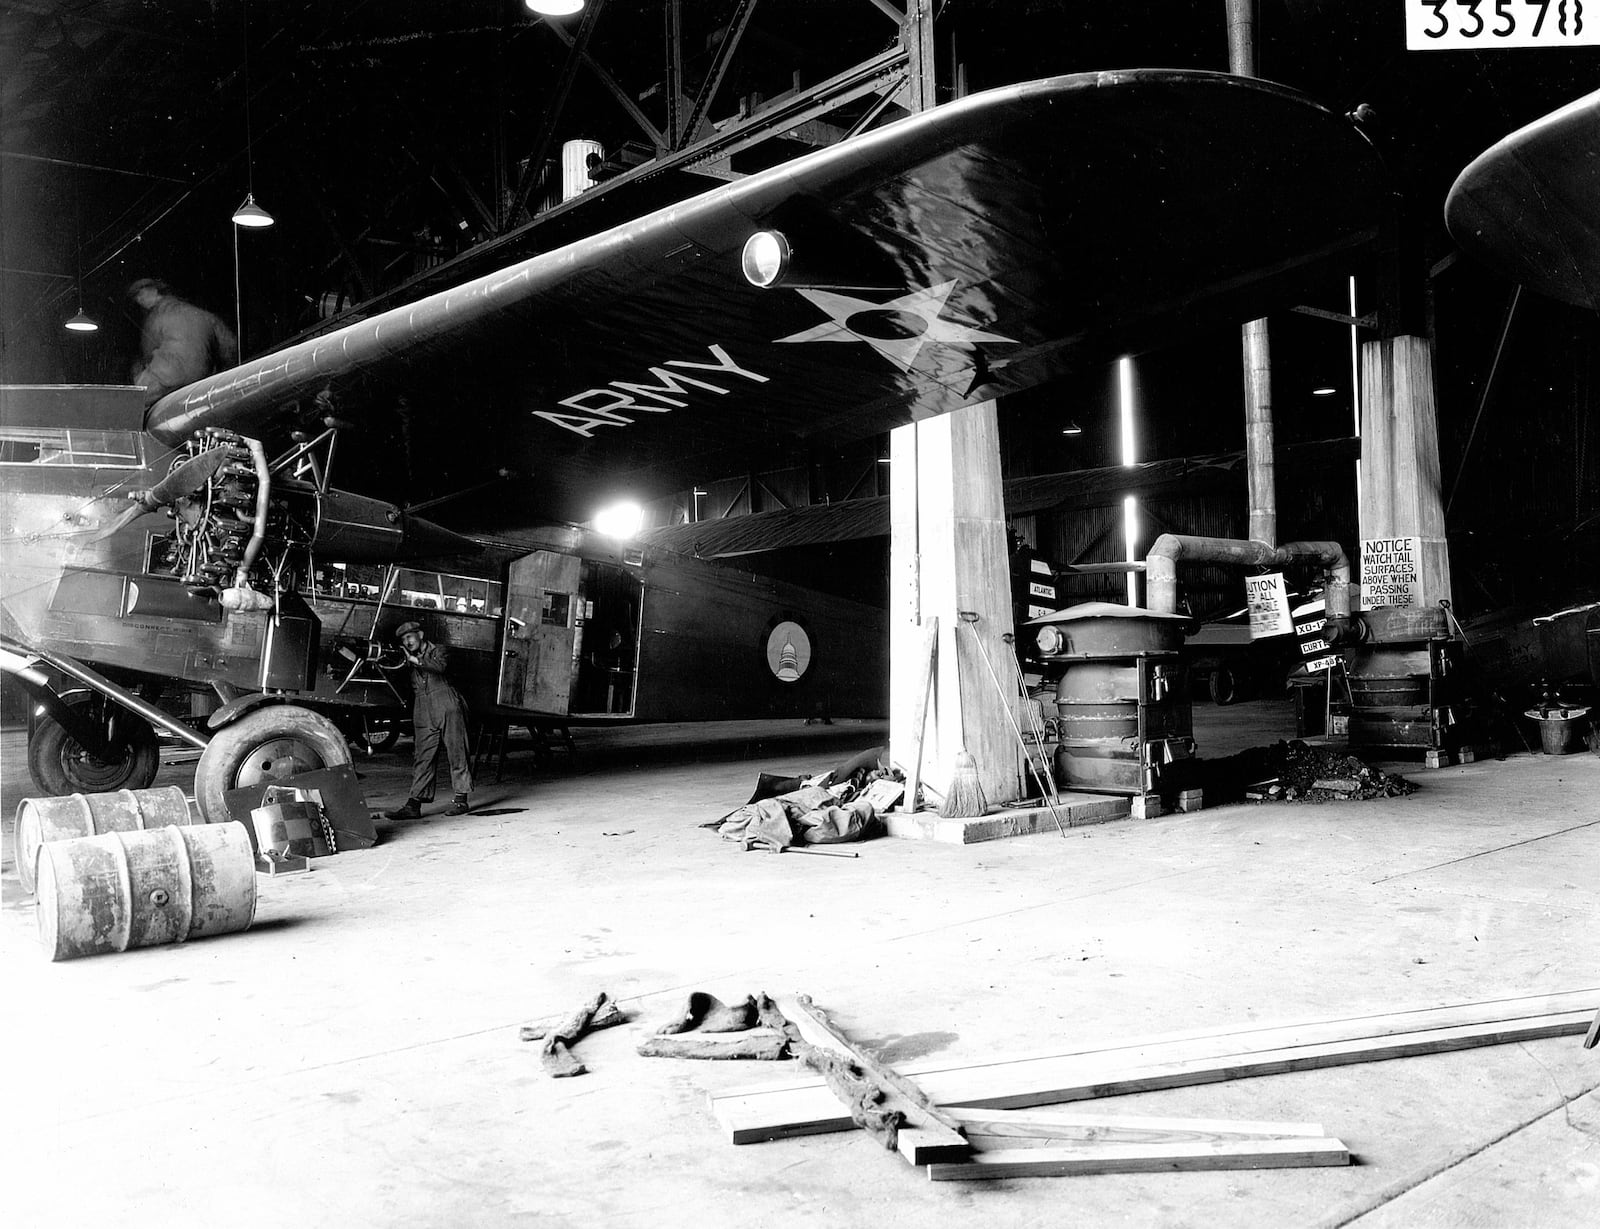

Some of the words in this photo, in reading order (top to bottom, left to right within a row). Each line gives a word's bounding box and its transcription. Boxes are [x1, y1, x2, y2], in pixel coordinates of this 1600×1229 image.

[531, 344, 771, 438] ARMY
[1366, 538, 1413, 554] NOTICE
[1362, 553, 1392, 565] WATCH
[1393, 552, 1414, 563] TAIL
[1364, 563, 1414, 575] SURFACES
[1362, 575, 1389, 585] ABOVE
[1390, 573, 1417, 583] WHEN
[1369, 583, 1409, 595] PASSING
[1260, 591, 1275, 601] ALL
[1362, 595, 1386, 606] UNDER
[1388, 594, 1415, 605] THESE
